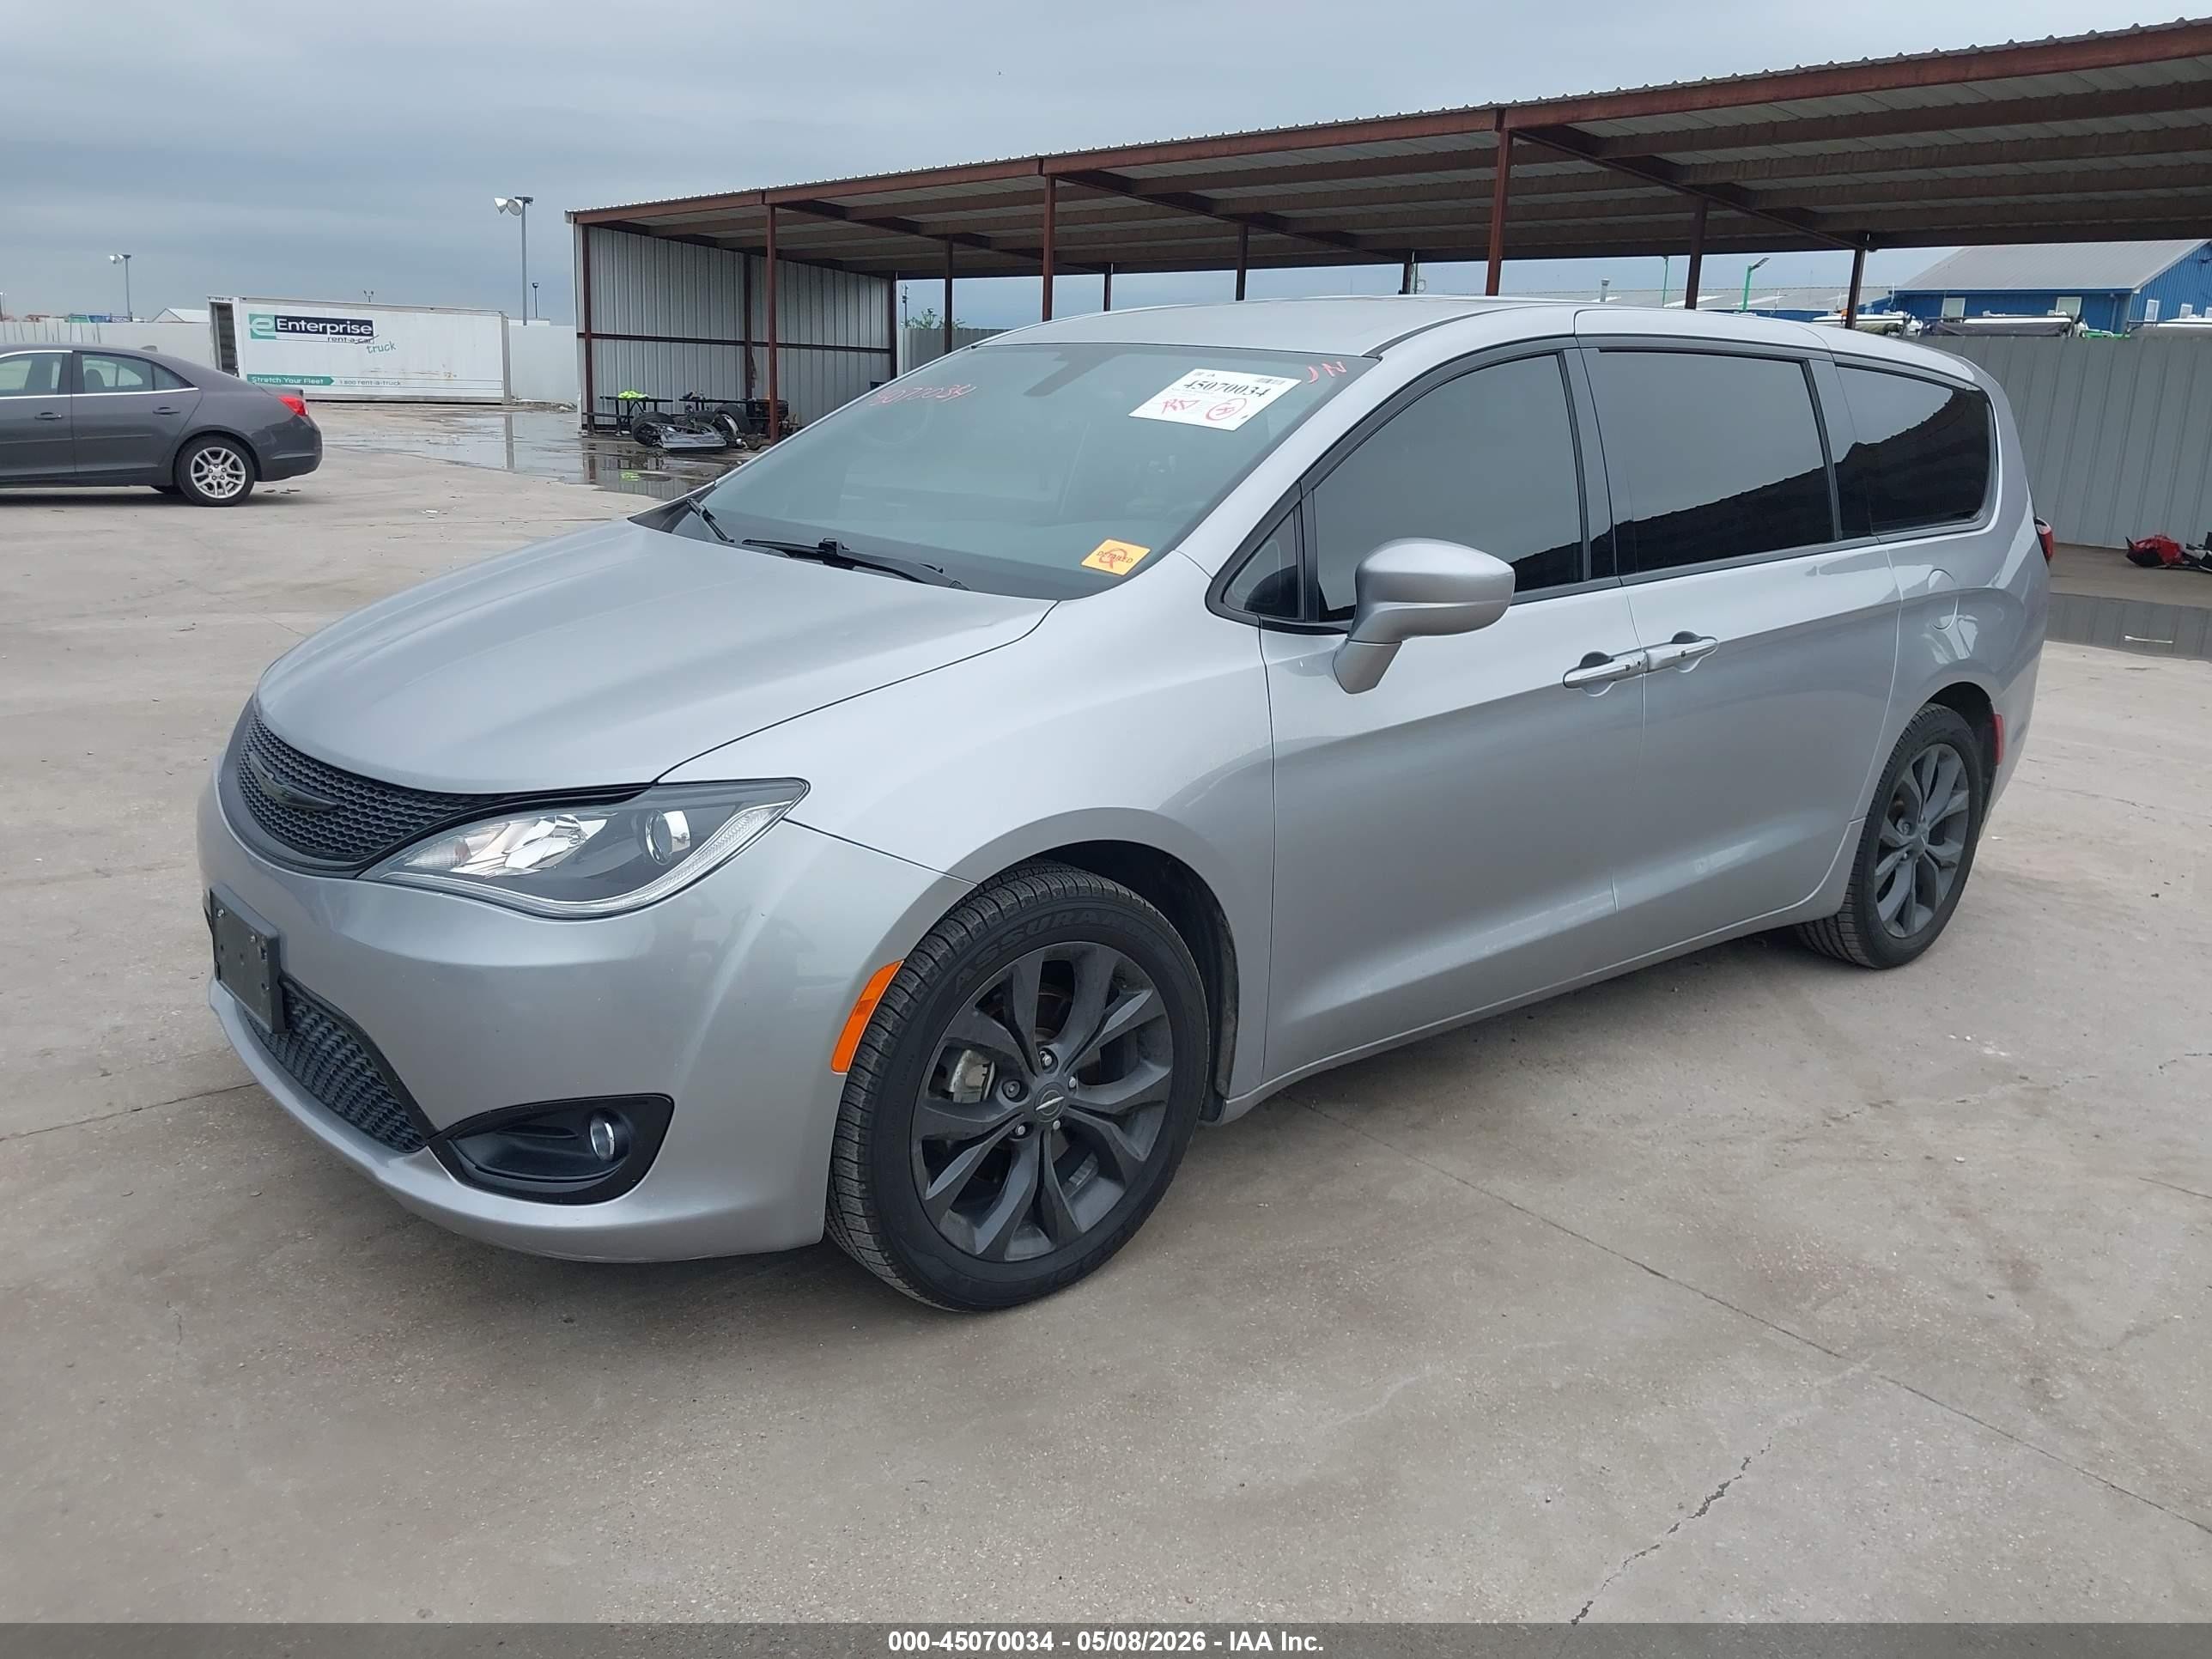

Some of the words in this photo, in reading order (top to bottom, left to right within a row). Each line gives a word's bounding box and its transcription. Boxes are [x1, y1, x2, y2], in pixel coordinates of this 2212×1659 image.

[276, 319, 373, 336] Enterprise
[366, 340, 397, 354] truck
[1183, 380, 1272, 398] 45070034
